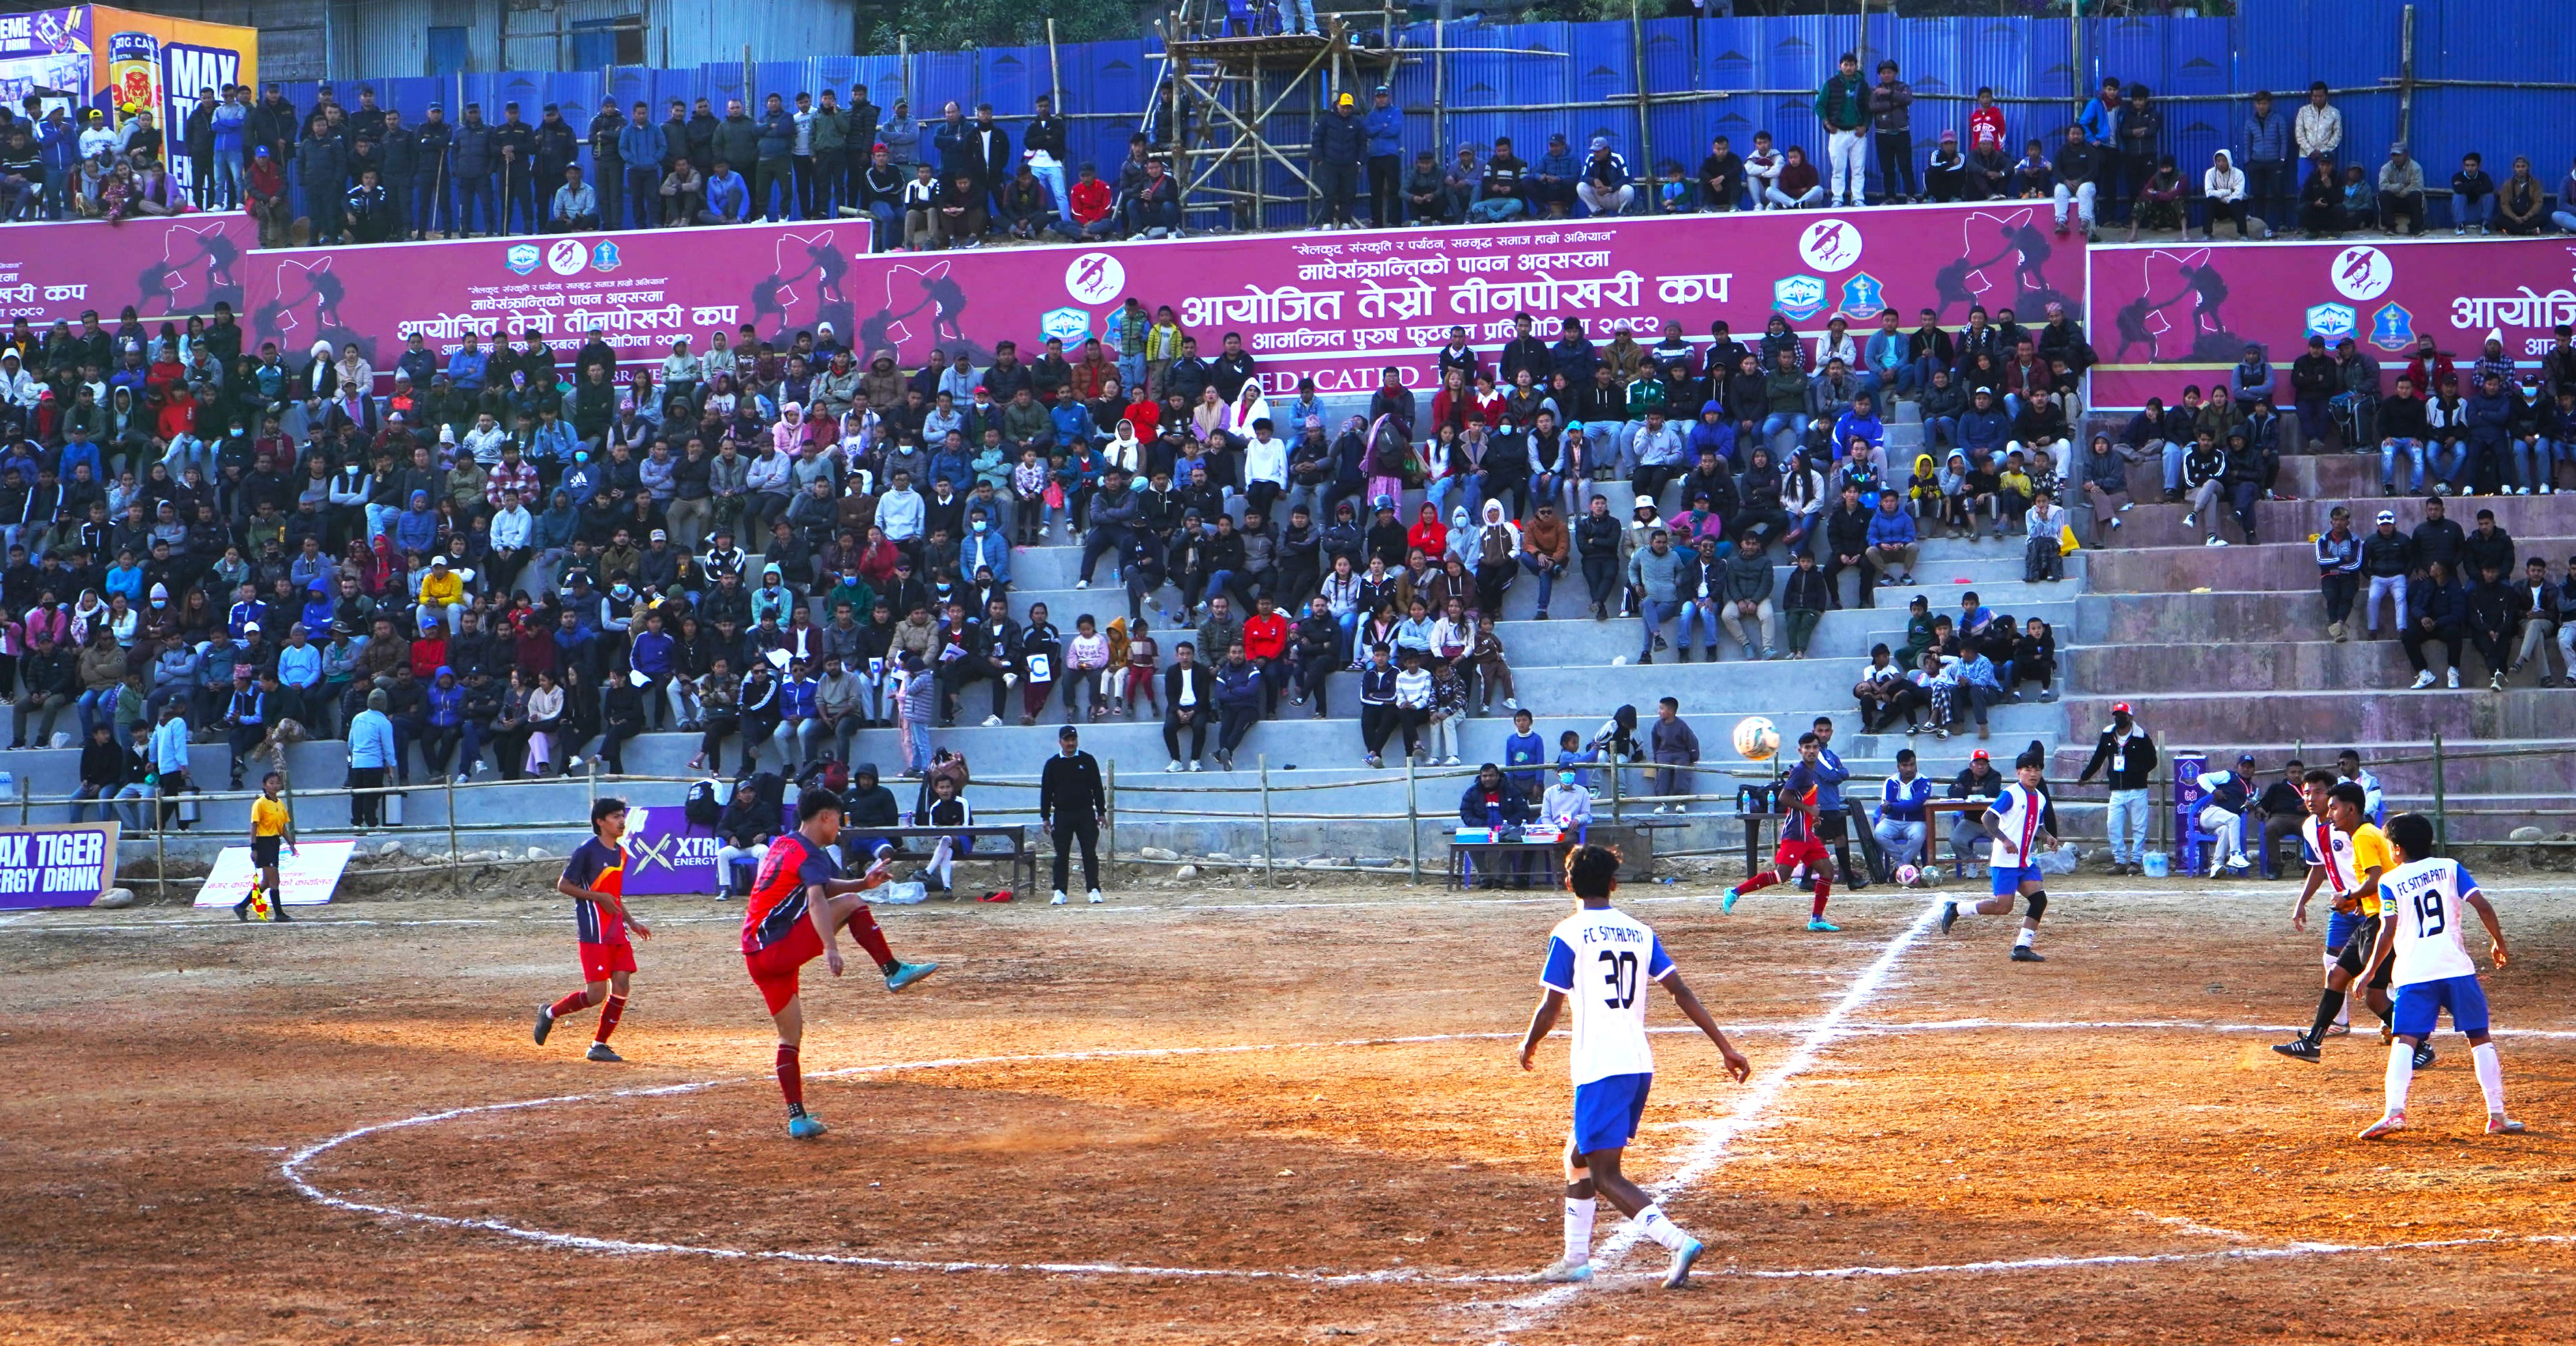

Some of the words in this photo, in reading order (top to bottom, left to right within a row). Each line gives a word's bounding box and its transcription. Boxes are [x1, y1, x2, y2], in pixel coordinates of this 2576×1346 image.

[5, 38, 31, 51] DRINK
[116, 37, 131, 49] BIG
[135, 37, 155, 51] CAN
[171, 48, 236, 101] MAX
[1396, 241, 1404, 250] र
[1496, 236, 1531, 246] समाज
[1457, 255, 1511, 273] पावन
[1517, 250, 1611, 271] अवसरमा
[43, 285, 88, 302] कप
[569, 293, 602, 306] पावन
[606, 291, 665, 304] अवसरमा
[1180, 284, 1344, 328] आयोजित
[1356, 276, 1436, 320] तेस्रो
[1448, 270, 1644, 314] तीनपोखरी
[1656, 274, 1732, 304] कप
[397, 313, 500, 341] आयोजित
[507, 308, 557, 335] तेस्रो
[563, 304, 685, 332] तीनपोखरी
[691, 305, 739, 326] कप
[1252, 328, 1346, 350] आमन्त्रित
[1352, 327, 1400, 350] पुरुष
[1031, 657, 1048, 678] C
[36, 833, 103, 867] TIGER
[674, 857, 718, 866] ENERGY
[0, 868, 40, 893] RGY
[42, 866, 101, 892] DRINK
[2397, 882, 2408, 896] FC
[2414, 888, 2445, 938] 19
[1584, 927, 1597, 944] FC
[1599, 950, 1638, 1010] 30
